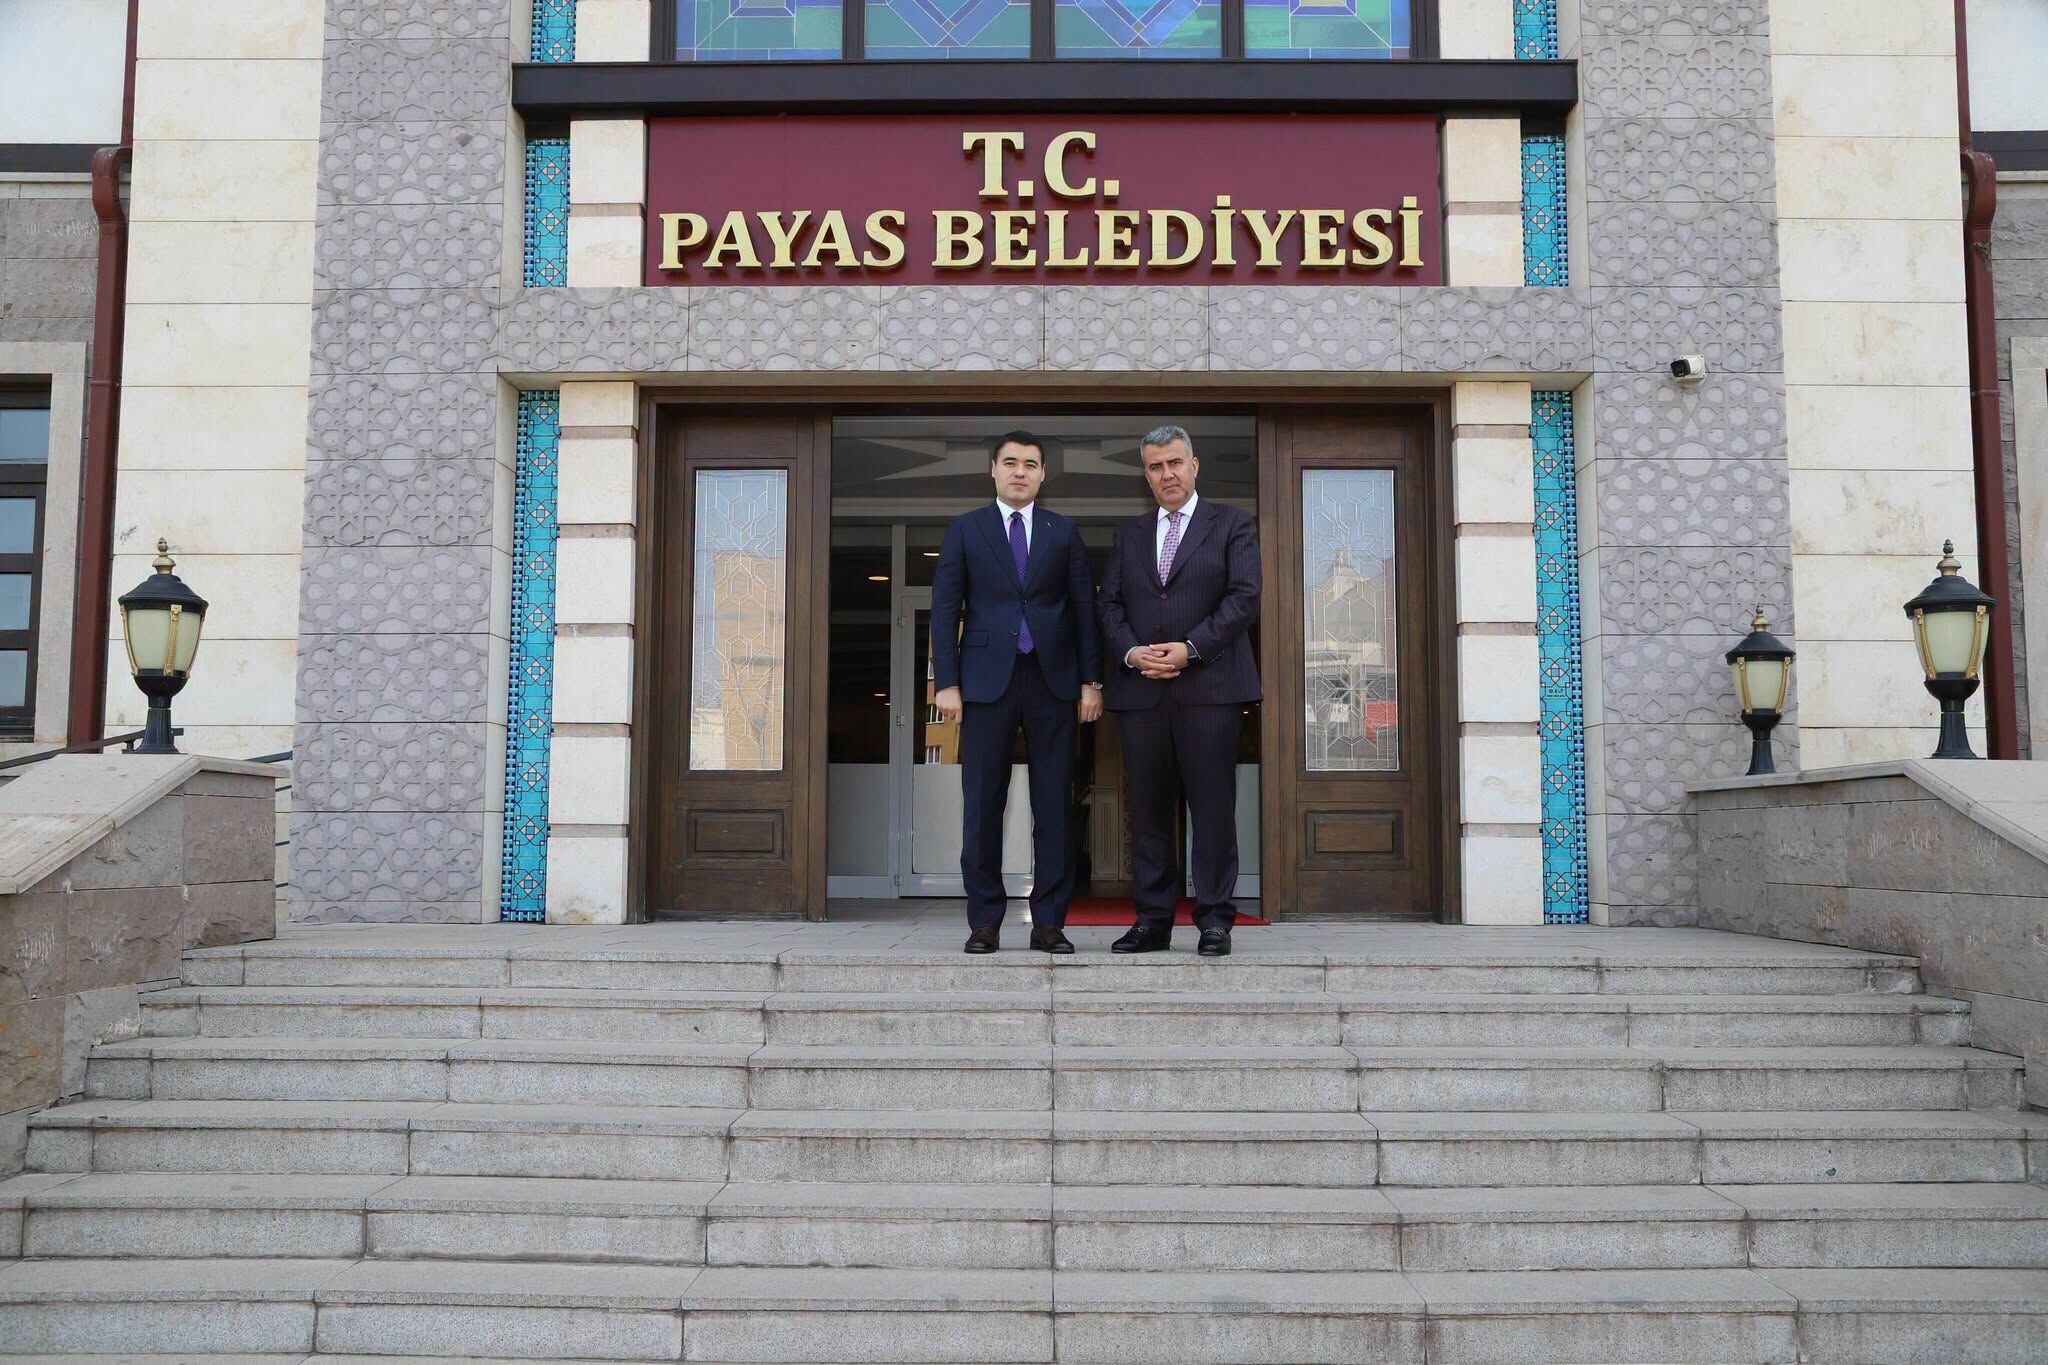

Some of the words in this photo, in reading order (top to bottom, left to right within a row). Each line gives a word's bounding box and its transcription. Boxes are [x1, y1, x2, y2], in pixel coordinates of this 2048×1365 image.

[962, 130, 1121, 198] T.C.
[657, 209, 907, 270] PAYAS
[930, 194, 1425, 269] BELEDİYESİ
